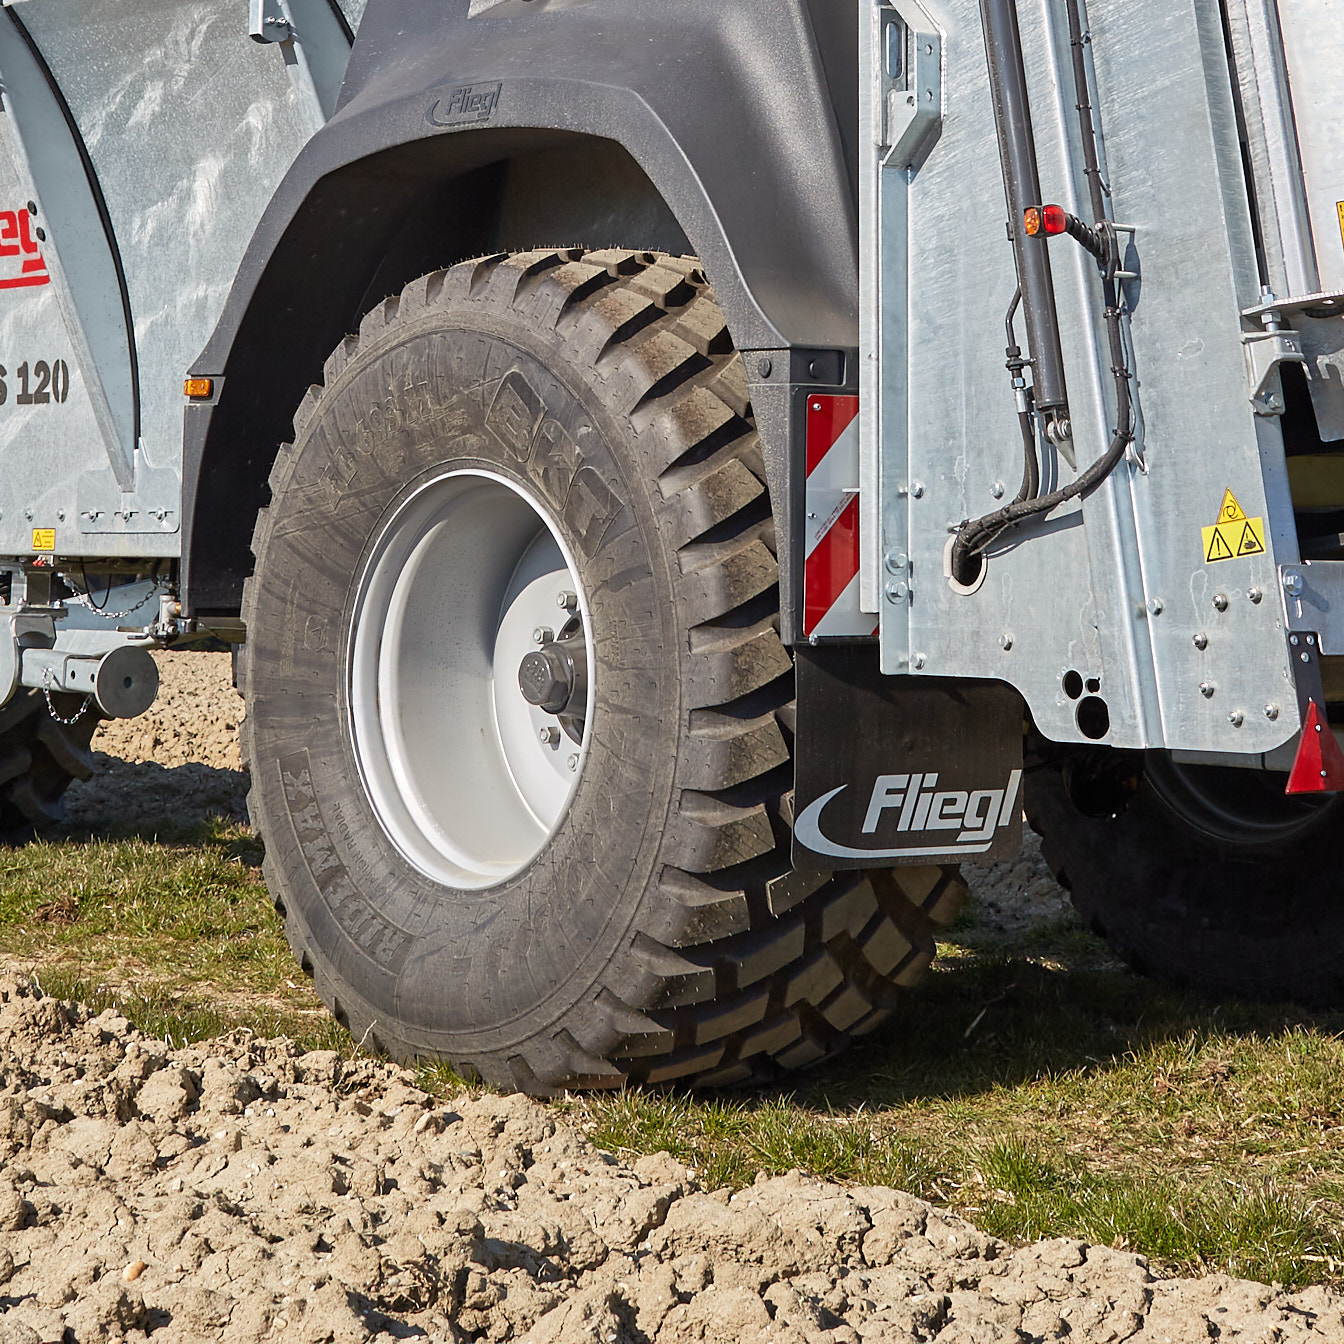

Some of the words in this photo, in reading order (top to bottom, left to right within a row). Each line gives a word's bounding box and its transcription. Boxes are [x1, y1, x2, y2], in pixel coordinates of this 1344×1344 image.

[445, 82, 503, 120] Fliegl
[16, 358, 70, 405] 120
[333, 800, 356, 852] RADIAL
[861, 768, 1023, 843] Fliegl
